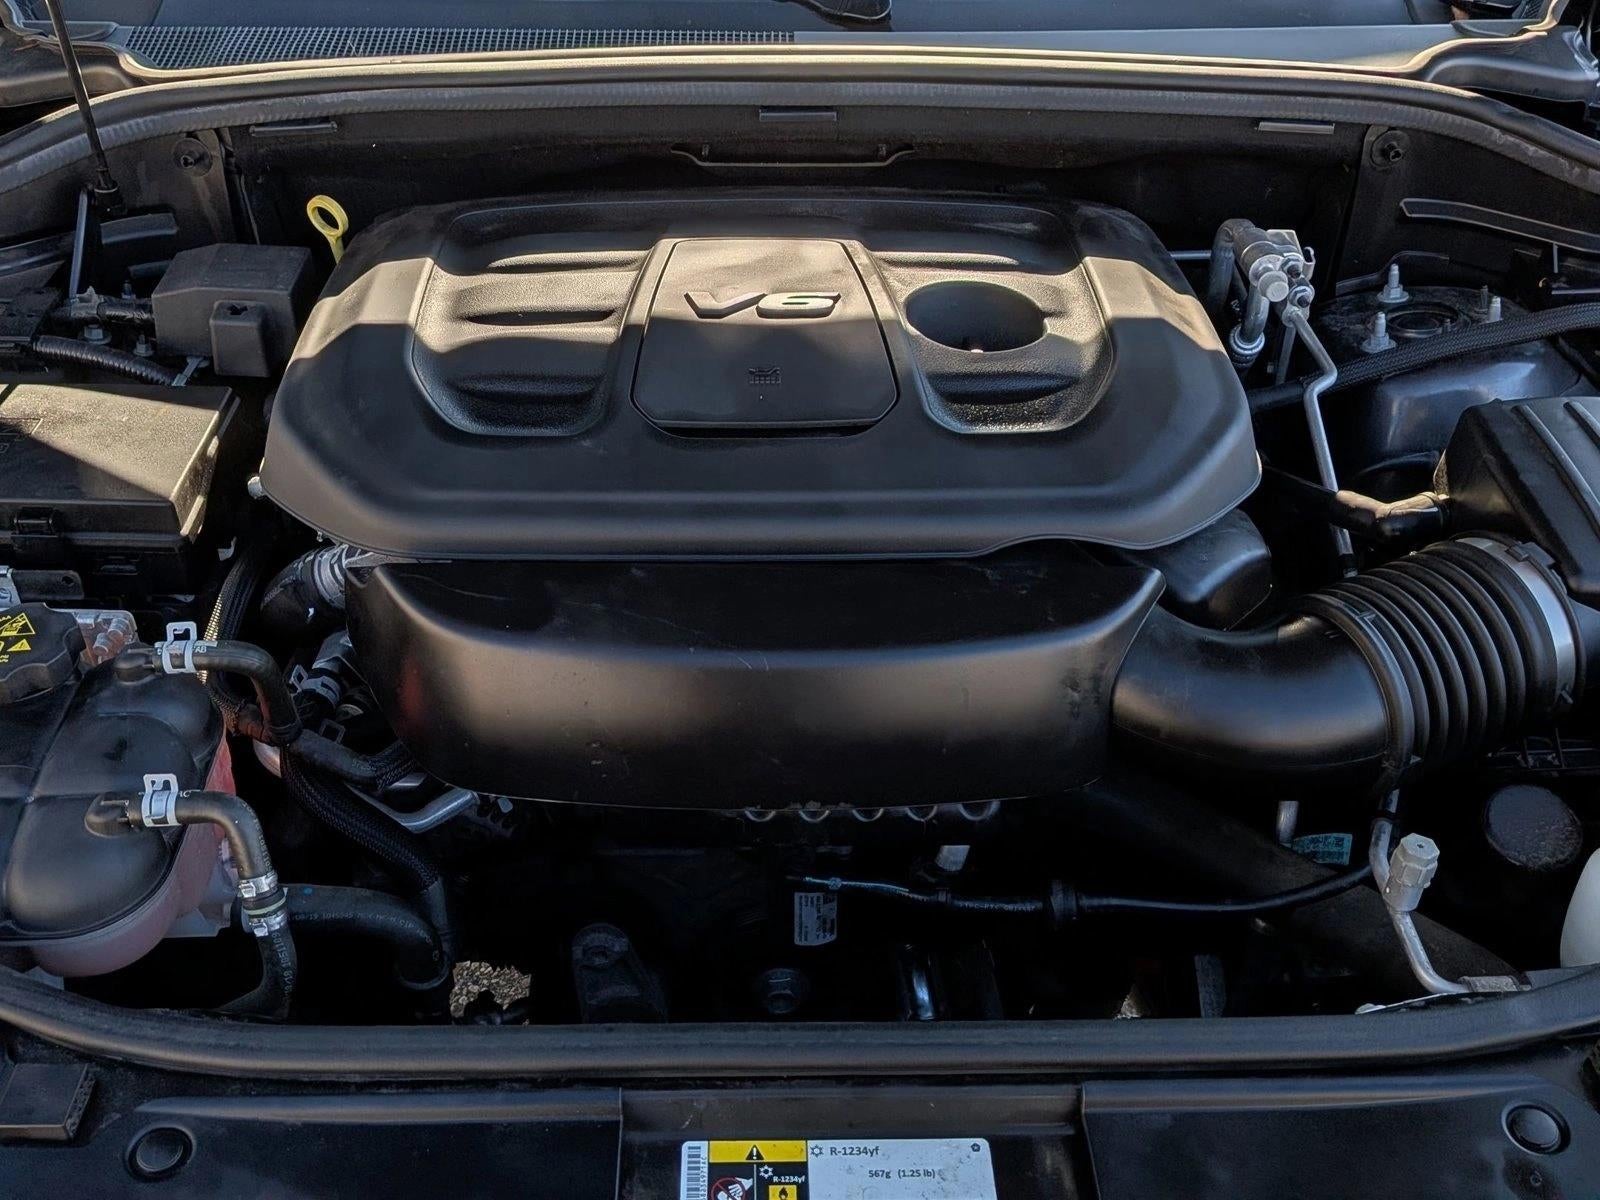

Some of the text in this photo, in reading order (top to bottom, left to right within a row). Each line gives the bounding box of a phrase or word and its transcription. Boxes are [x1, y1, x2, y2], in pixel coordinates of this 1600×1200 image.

[683, 291, 842, 319] V6
[829, 1146, 880, 1157] R-1234yf
[868, 1169, 936, 1179] 567g (1.25 lb)
[772, 1175, 806, 1184] R-1234yf
